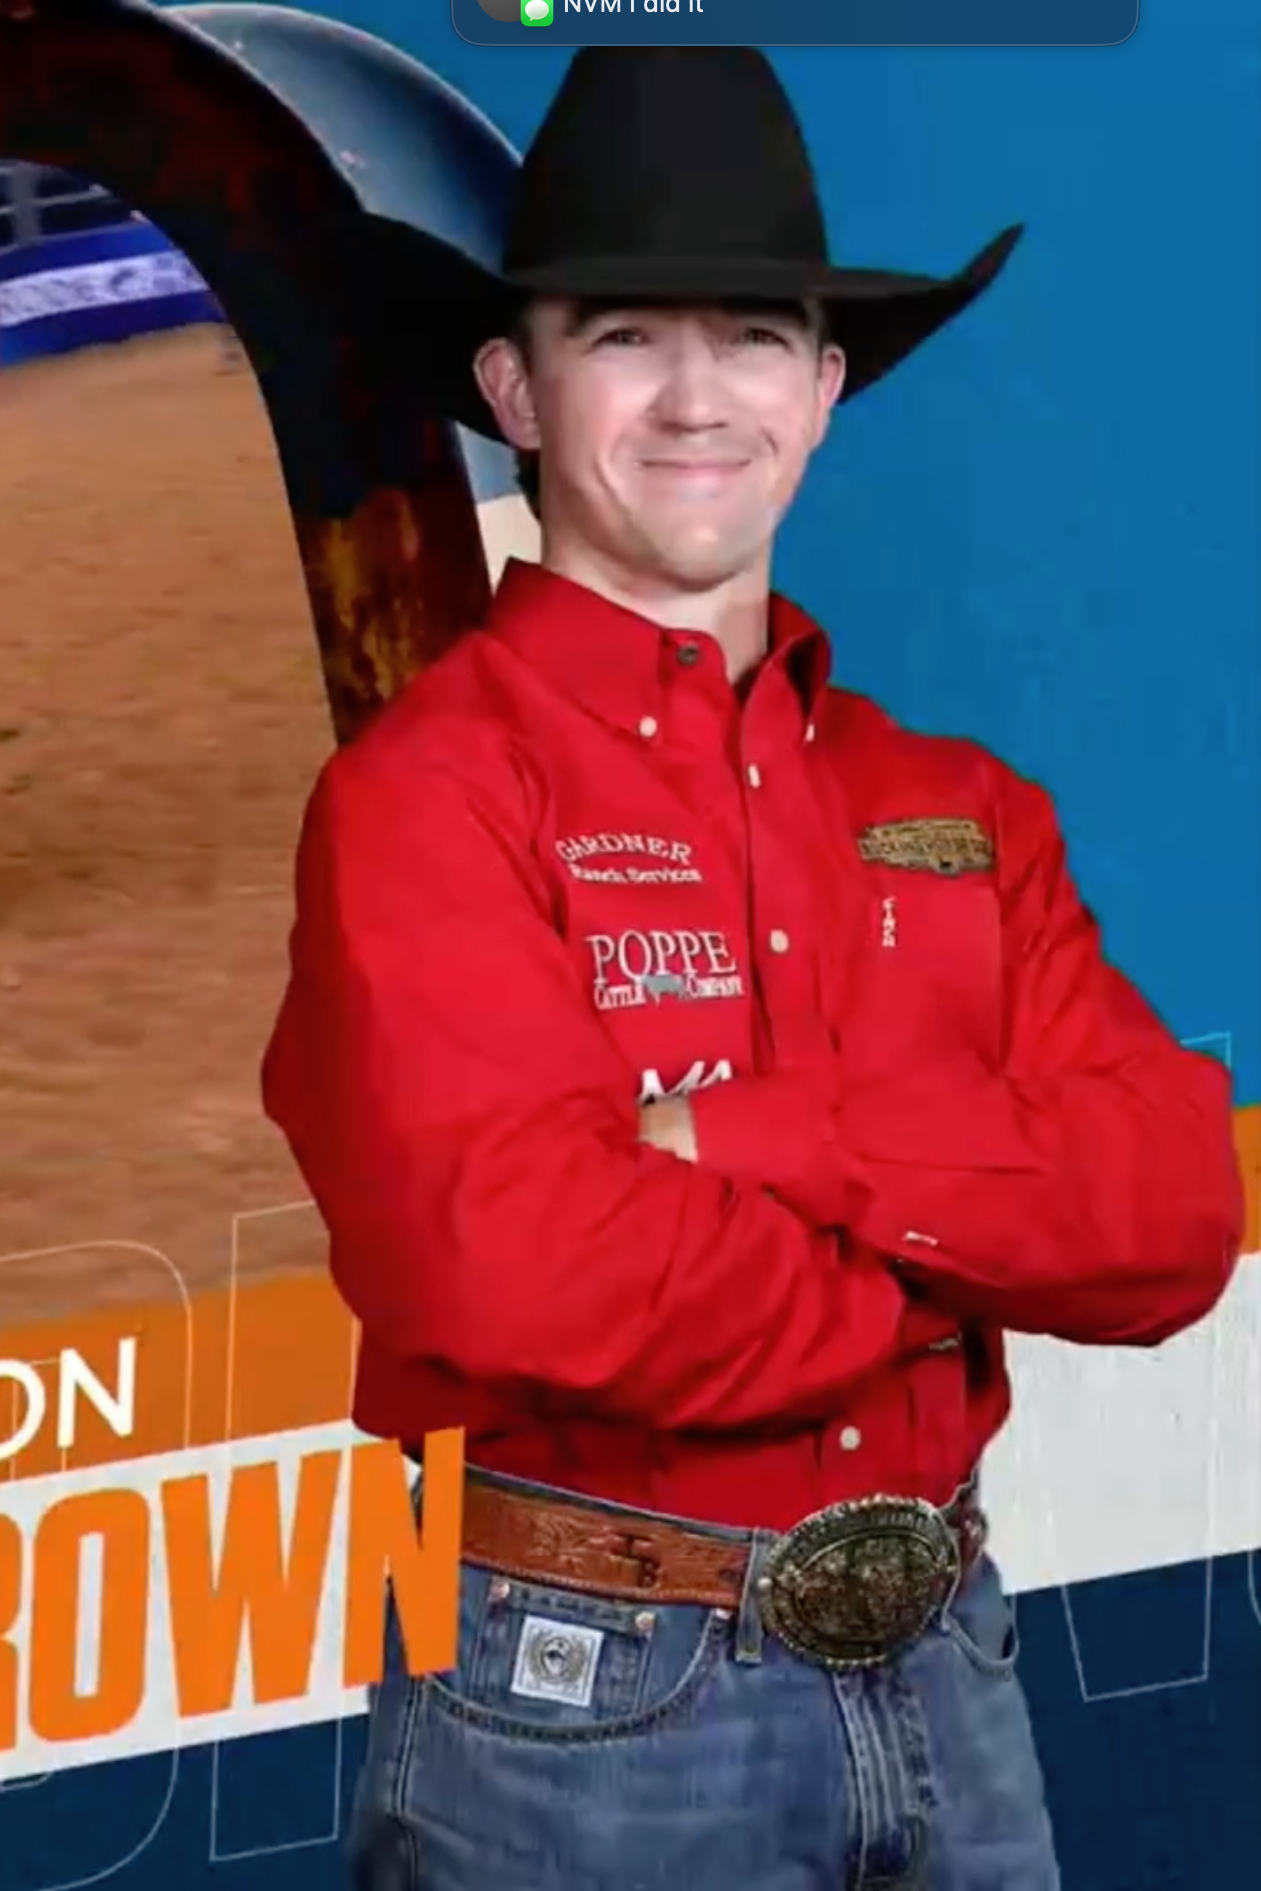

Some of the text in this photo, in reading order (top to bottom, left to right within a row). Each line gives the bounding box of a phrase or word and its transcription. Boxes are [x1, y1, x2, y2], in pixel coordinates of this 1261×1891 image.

[555, 832, 692, 866] GARDNER
[626, 866, 703, 884] Services
[585, 929, 737, 984] POPPE
